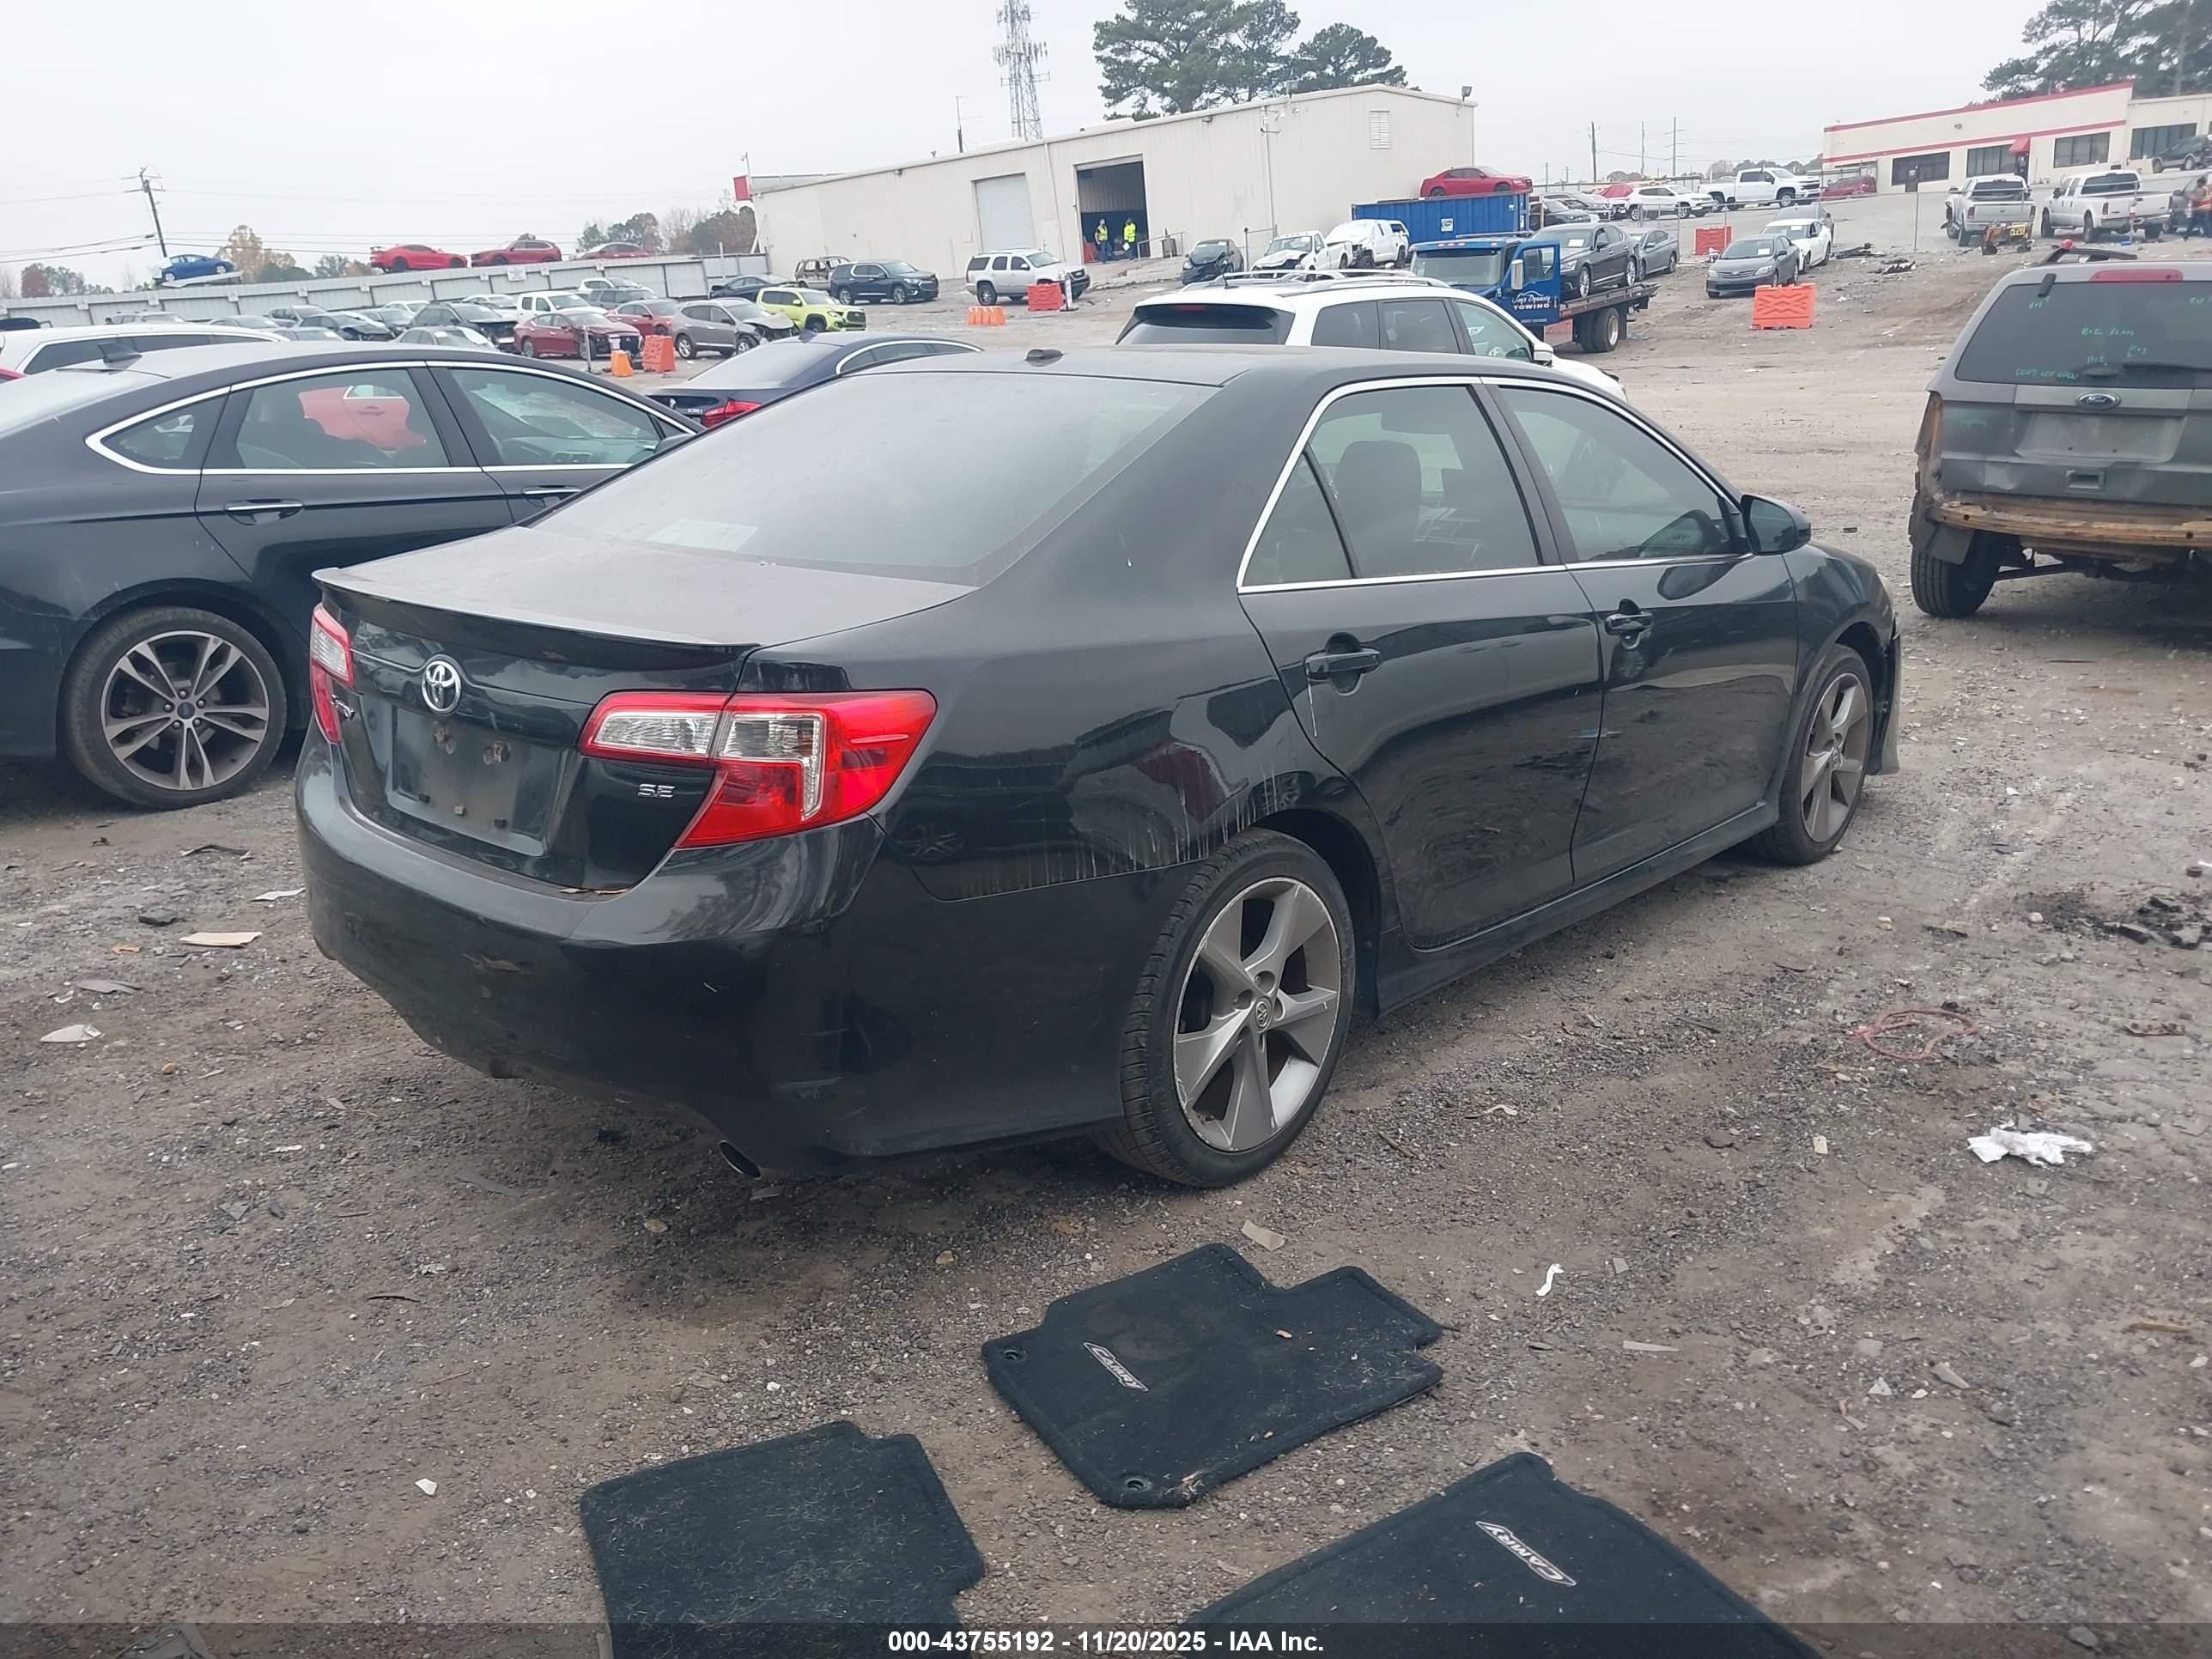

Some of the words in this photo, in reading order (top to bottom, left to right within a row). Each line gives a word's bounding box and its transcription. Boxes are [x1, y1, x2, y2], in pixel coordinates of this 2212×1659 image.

[638, 783, 676, 798] SE
[1090, 1346, 1144, 1389] CAMRY
[1483, 1525, 1564, 1580] CAMRY
